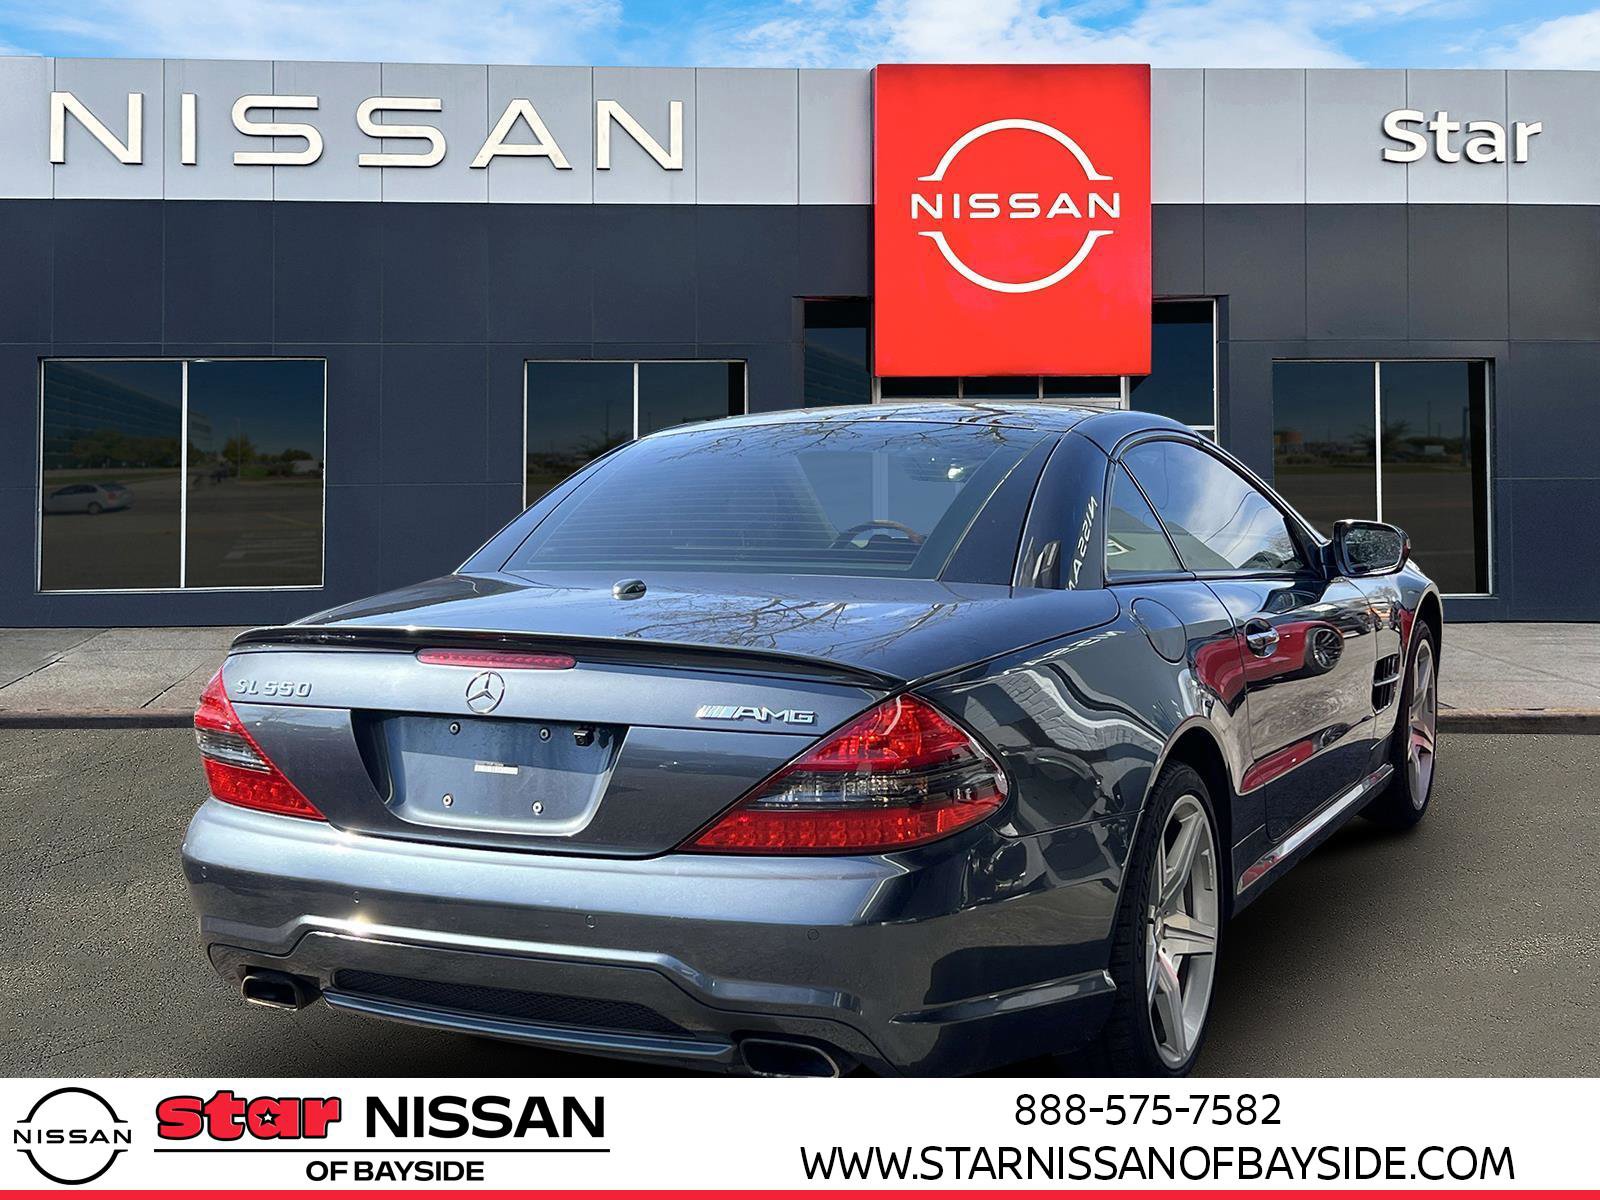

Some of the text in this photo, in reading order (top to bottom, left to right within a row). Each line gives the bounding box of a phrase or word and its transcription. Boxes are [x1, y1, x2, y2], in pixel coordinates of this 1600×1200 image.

[49, 91, 684, 170] NISSAN
[1382, 109, 1543, 165] Star
[911, 192, 1121, 220] NISSAN
[236, 679, 313, 698] SL 550
[732, 705, 817, 724] AMG
